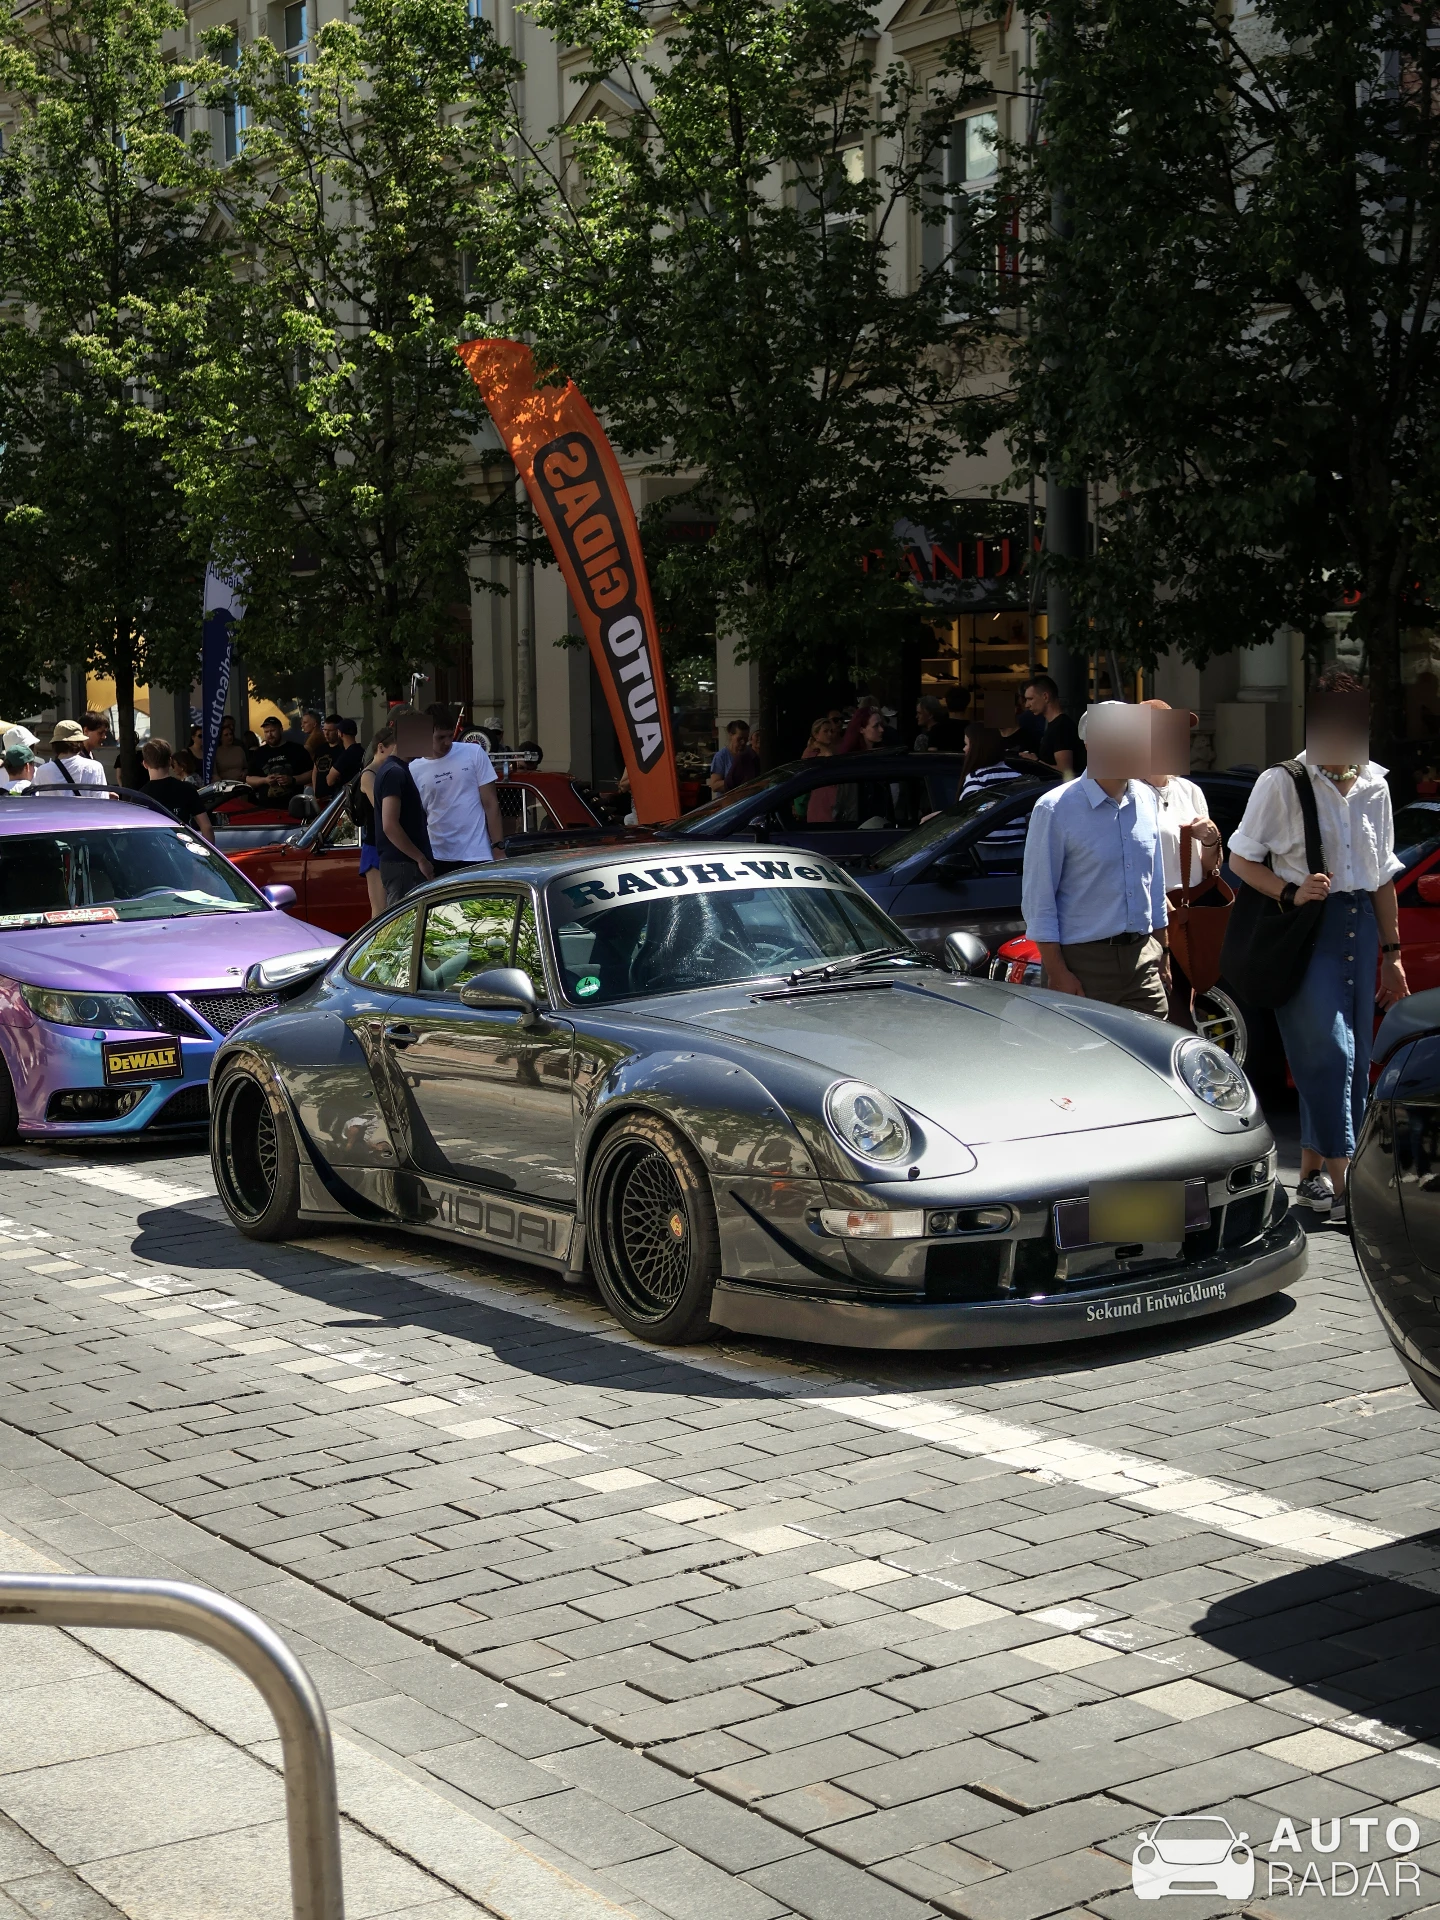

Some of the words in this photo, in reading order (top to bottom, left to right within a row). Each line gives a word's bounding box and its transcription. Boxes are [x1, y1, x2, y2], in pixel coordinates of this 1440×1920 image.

[417, 1184, 556, 1251] KIÖDAI
[1086, 1296, 1142, 1322] Sekund
[1146, 1282, 1227, 1312] Entwicklung
